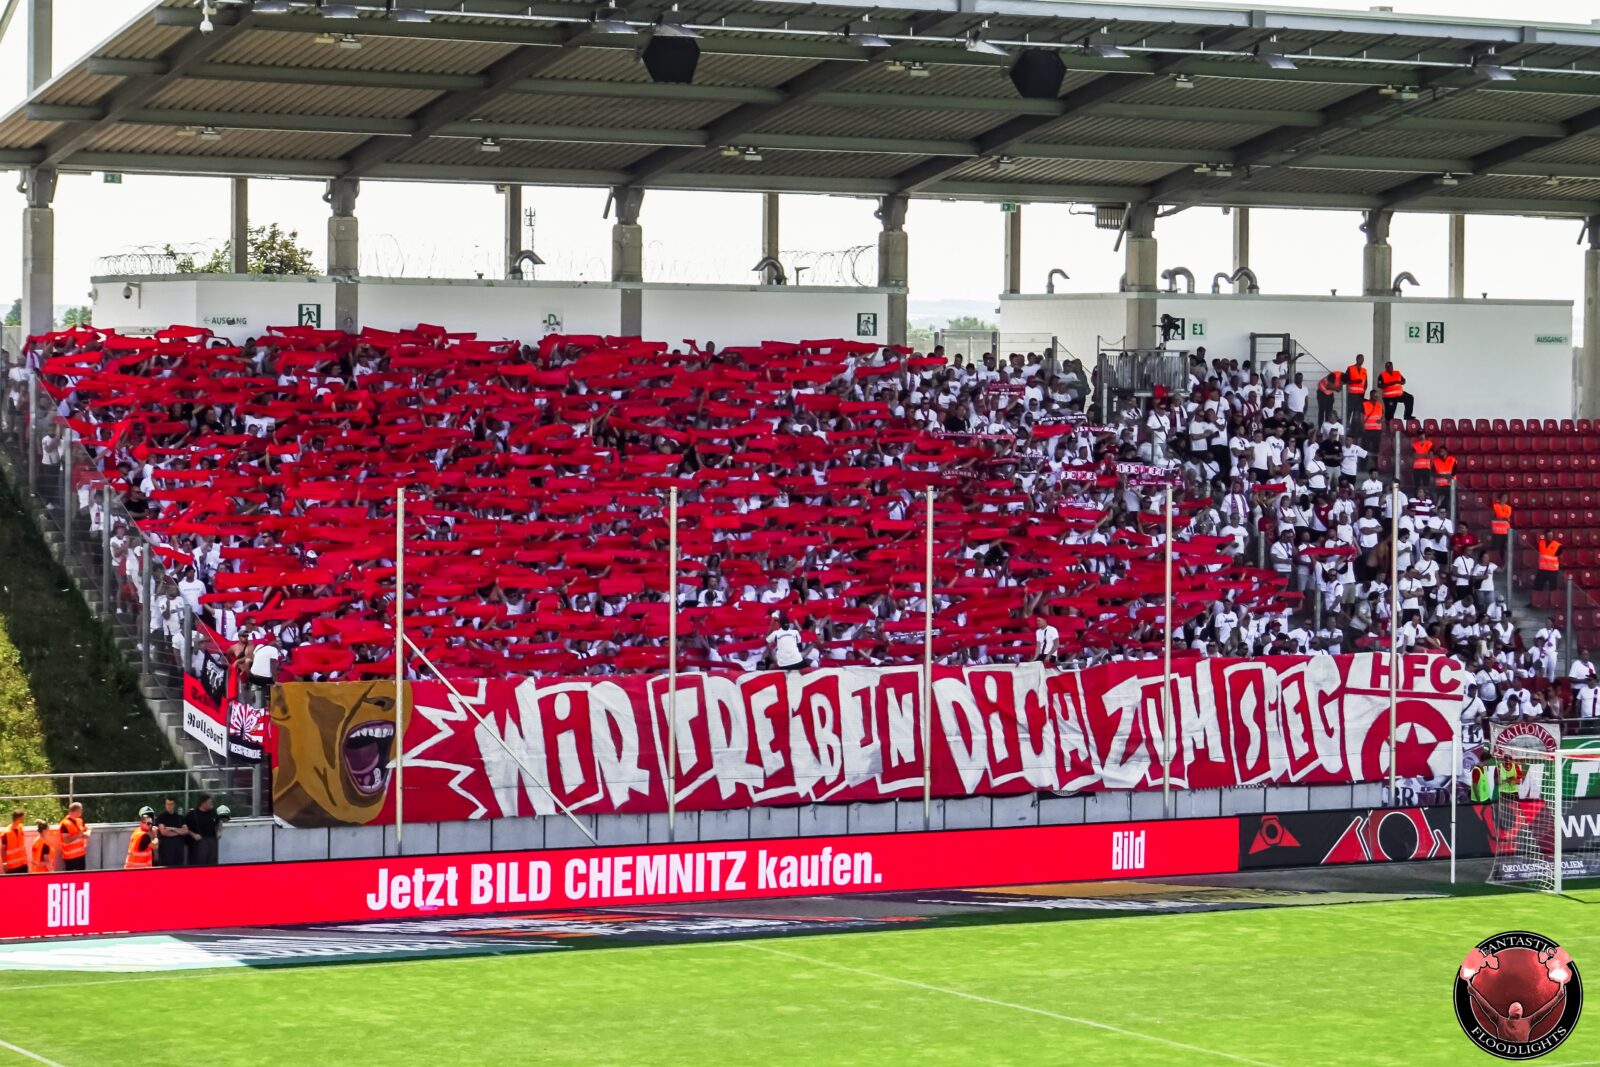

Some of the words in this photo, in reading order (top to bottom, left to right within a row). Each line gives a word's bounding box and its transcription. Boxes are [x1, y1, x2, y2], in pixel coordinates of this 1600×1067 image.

[1192, 323, 1204, 335] E1
[1408, 326, 1420, 338] E2
[1536, 335, 1562, 343] AUSGANG
[1370, 652, 1462, 693] HFC
[1112, 830, 1145, 870] Bild
[366, 866, 458, 910] Jetzt
[471, 860, 551, 905] BILD
[564, 851, 747, 900] CHEMNITZ
[758, 847, 882, 890] kaufen.
[47, 882, 91, 928] Bild
